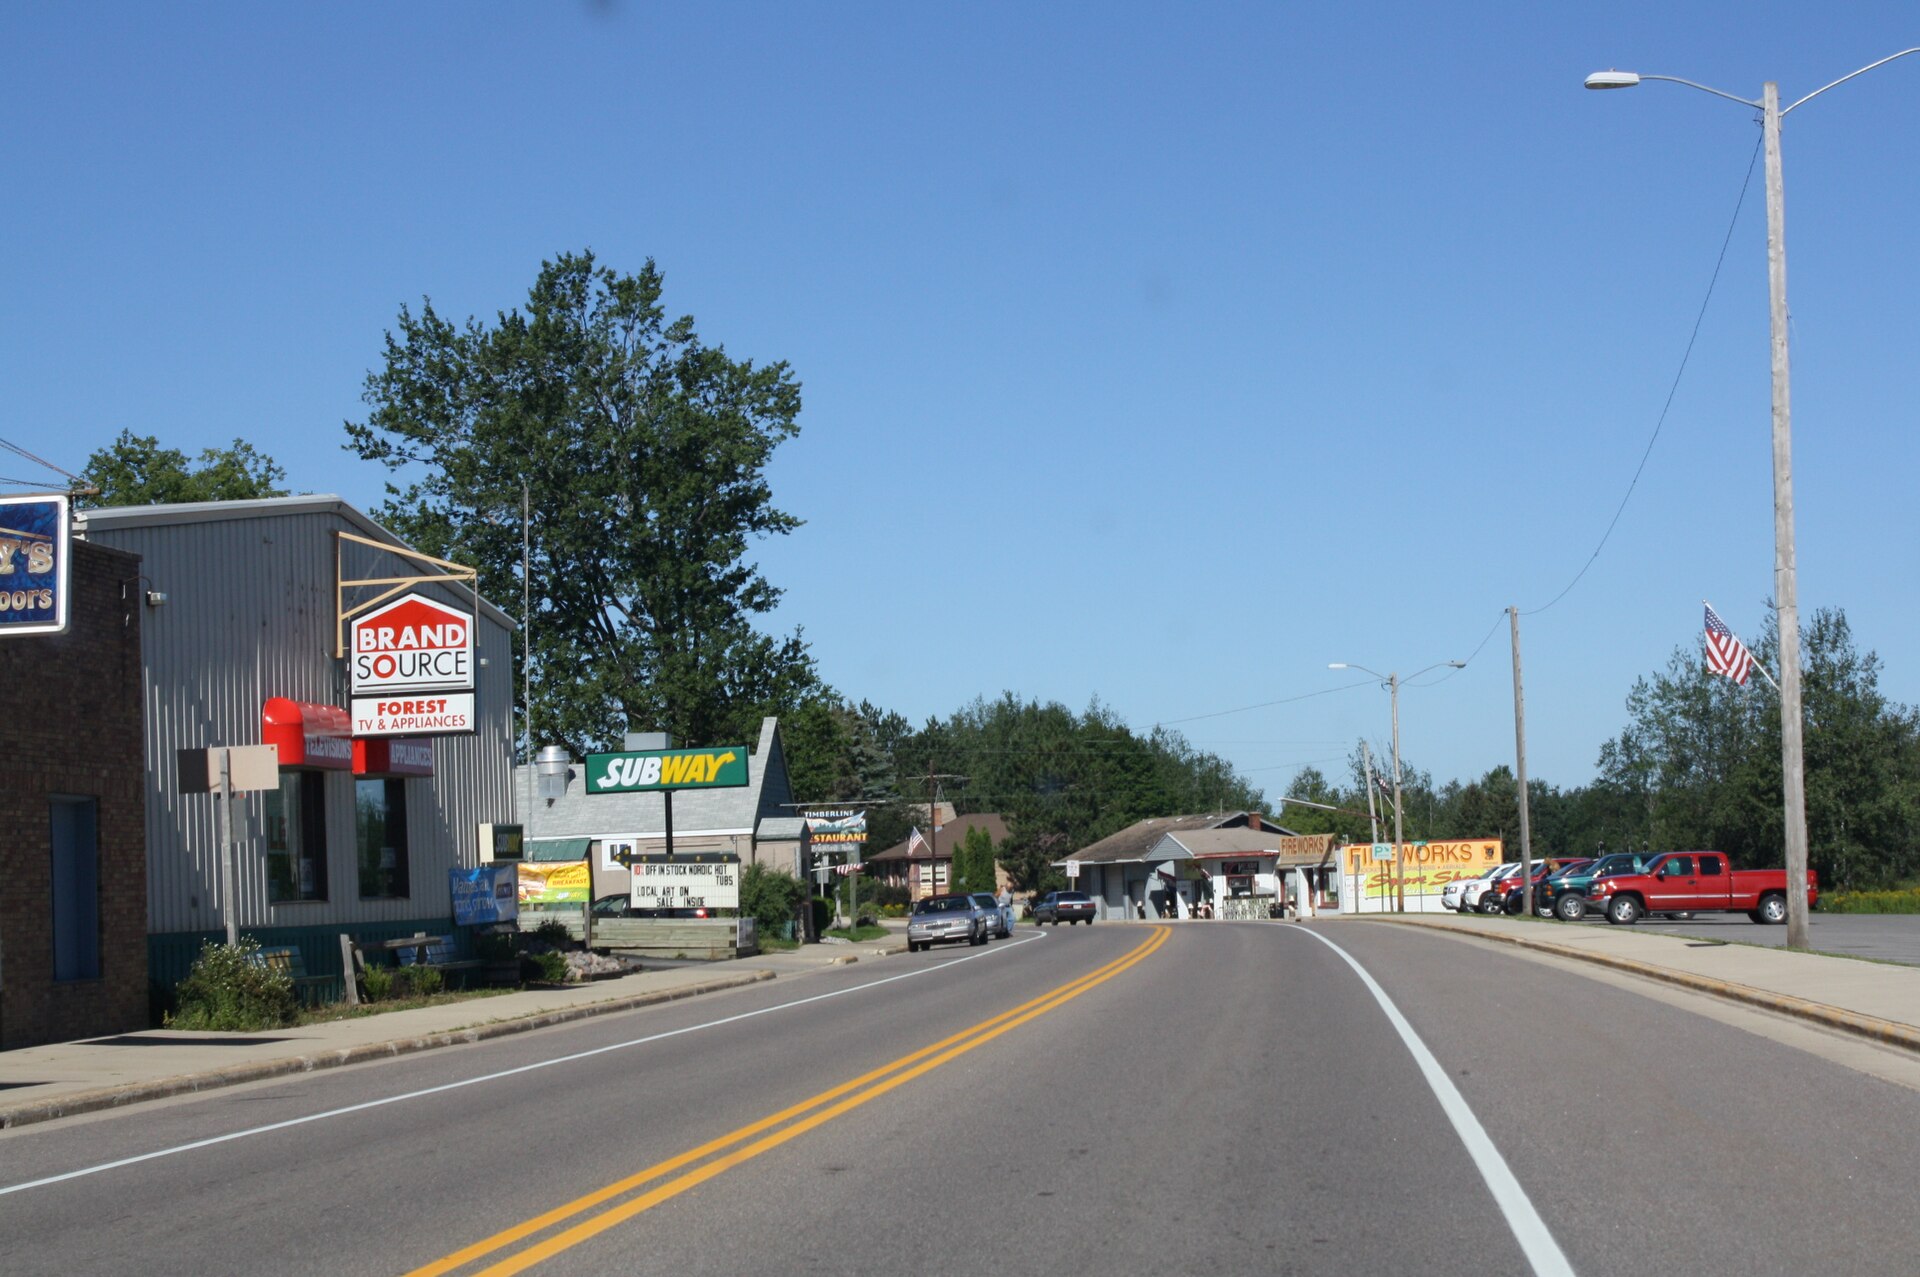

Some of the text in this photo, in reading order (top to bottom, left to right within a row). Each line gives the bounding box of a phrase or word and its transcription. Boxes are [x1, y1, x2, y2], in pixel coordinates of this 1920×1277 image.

[359, 623, 466, 651] BRAND
[356, 651, 467, 680] SOURCE
[377, 699, 447, 716] FOREST
[358, 715, 466, 731] TV & APPLIANCES
[305, 735, 351, 759] TELEVISIONS
[391, 743, 433, 767] APPLIANCES
[597, 751, 736, 789] SUBWAY
[804, 810, 854, 818] TIMBERLINE
[1281, 836, 1324, 856] FIREWORKS
[645, 865, 656, 875] OFF
[658, 866, 665, 875] IN
[665, 865, 687, 875] STOCK
[689, 865, 712, 875] NORDIC
[714, 864, 728, 875] HOT
[552, 878, 587, 886] BREAKFAST
[716, 875, 734, 886] TUBS
[637, 886, 689, 896] LOCAL ART ON
[656, 896, 705, 907] SALE INSIDE
